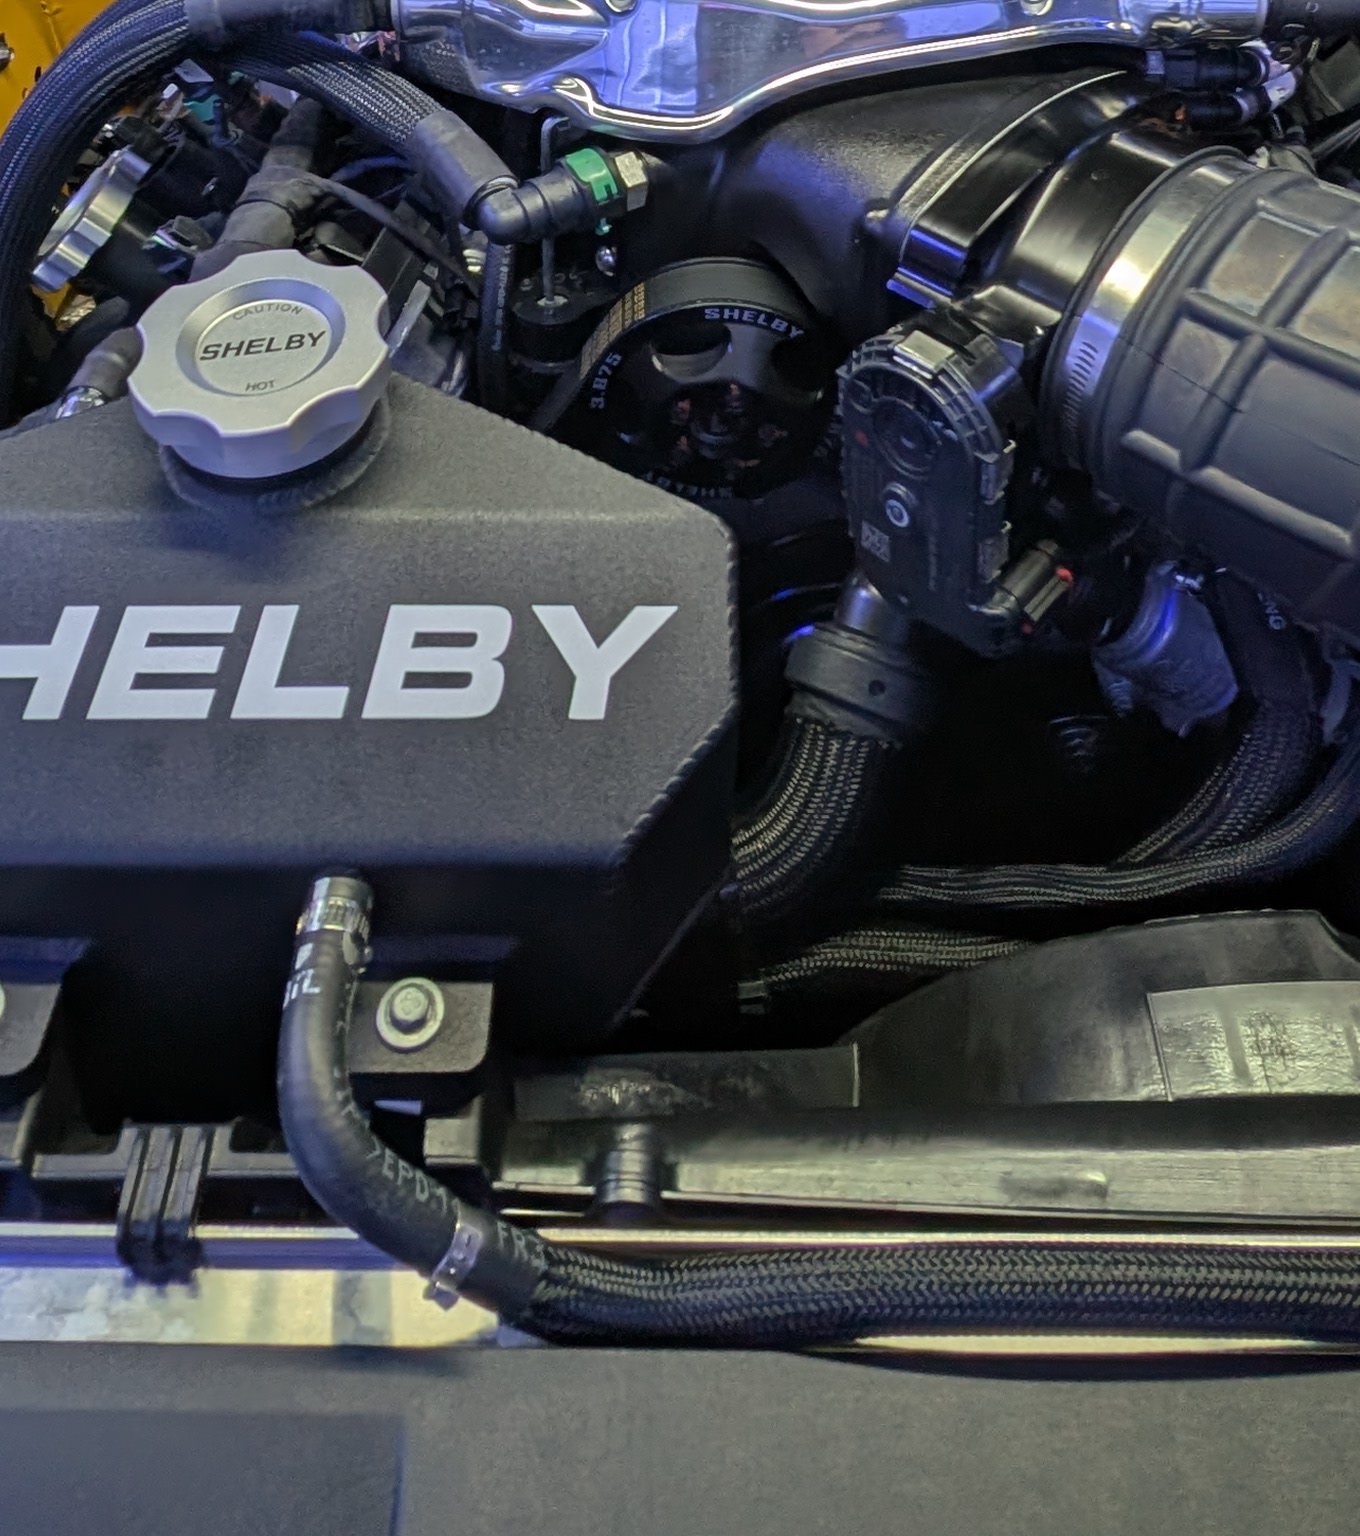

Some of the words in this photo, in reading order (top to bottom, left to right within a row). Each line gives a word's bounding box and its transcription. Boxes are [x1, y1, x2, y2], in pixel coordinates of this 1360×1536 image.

[232, 302, 304, 322] CAUTION
[704, 307, 806, 340] SHELBY
[199, 330, 327, 362] SHELBY
[245, 379, 276, 393] HOT
